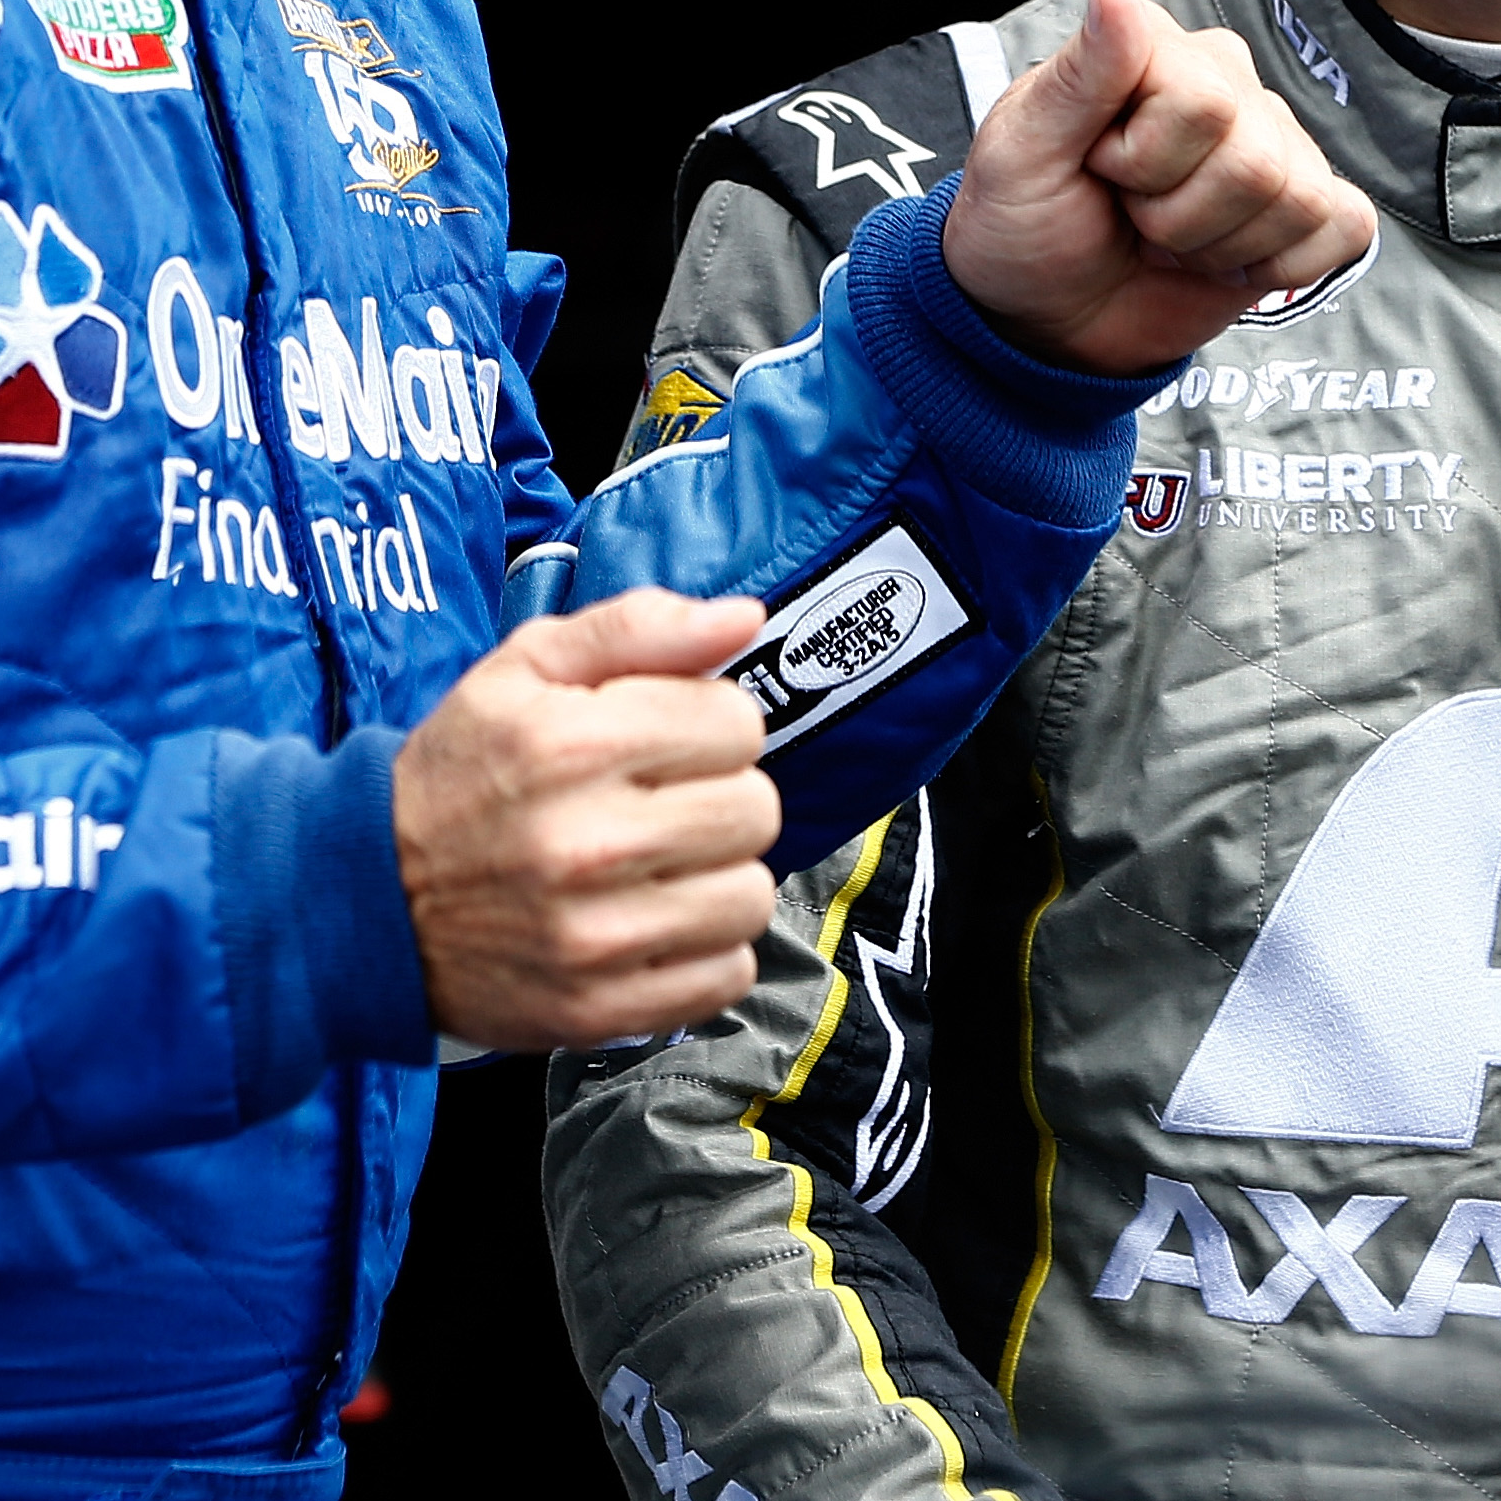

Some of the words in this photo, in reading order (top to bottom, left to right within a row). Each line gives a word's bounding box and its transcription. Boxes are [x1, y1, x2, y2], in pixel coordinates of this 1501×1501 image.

[1198, 447, 1464, 503] LIBERTY
[1198, 502, 1460, 533] UNIVERSITY
[785, 577, 901, 668] MANUFACTURER
[816, 607, 895, 669] CERTIFIED
